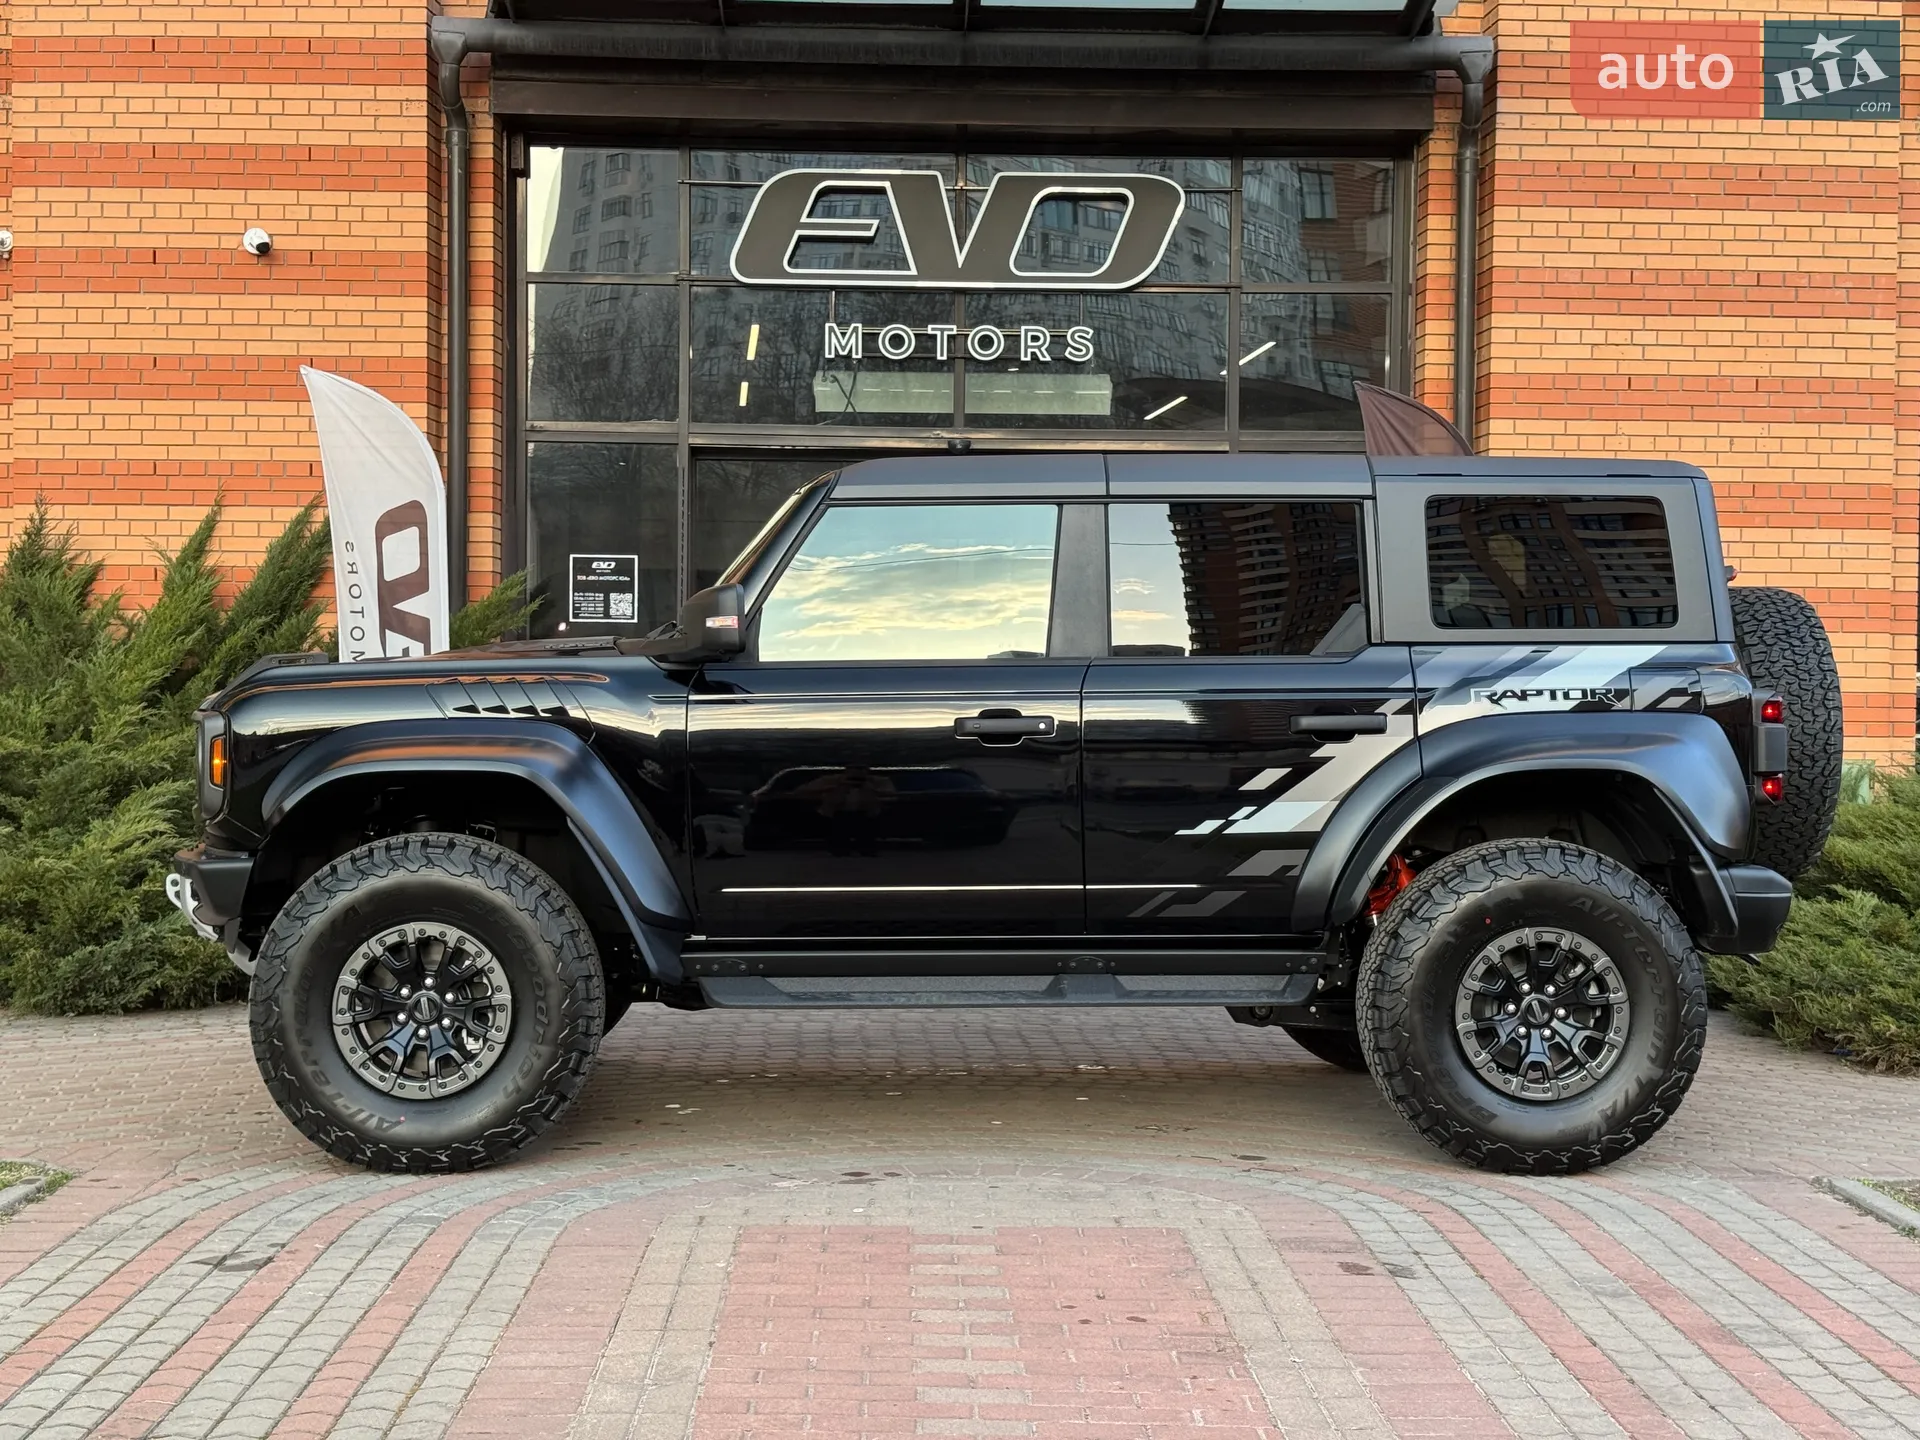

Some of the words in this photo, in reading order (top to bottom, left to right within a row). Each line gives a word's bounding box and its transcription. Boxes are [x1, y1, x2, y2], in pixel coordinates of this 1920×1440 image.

[729, 168, 1186, 290] EVO
[824, 322, 1095, 362] MOTORS
[591, 561, 616, 569] EVO
[1470, 688, 1622, 710] RAPTOR
